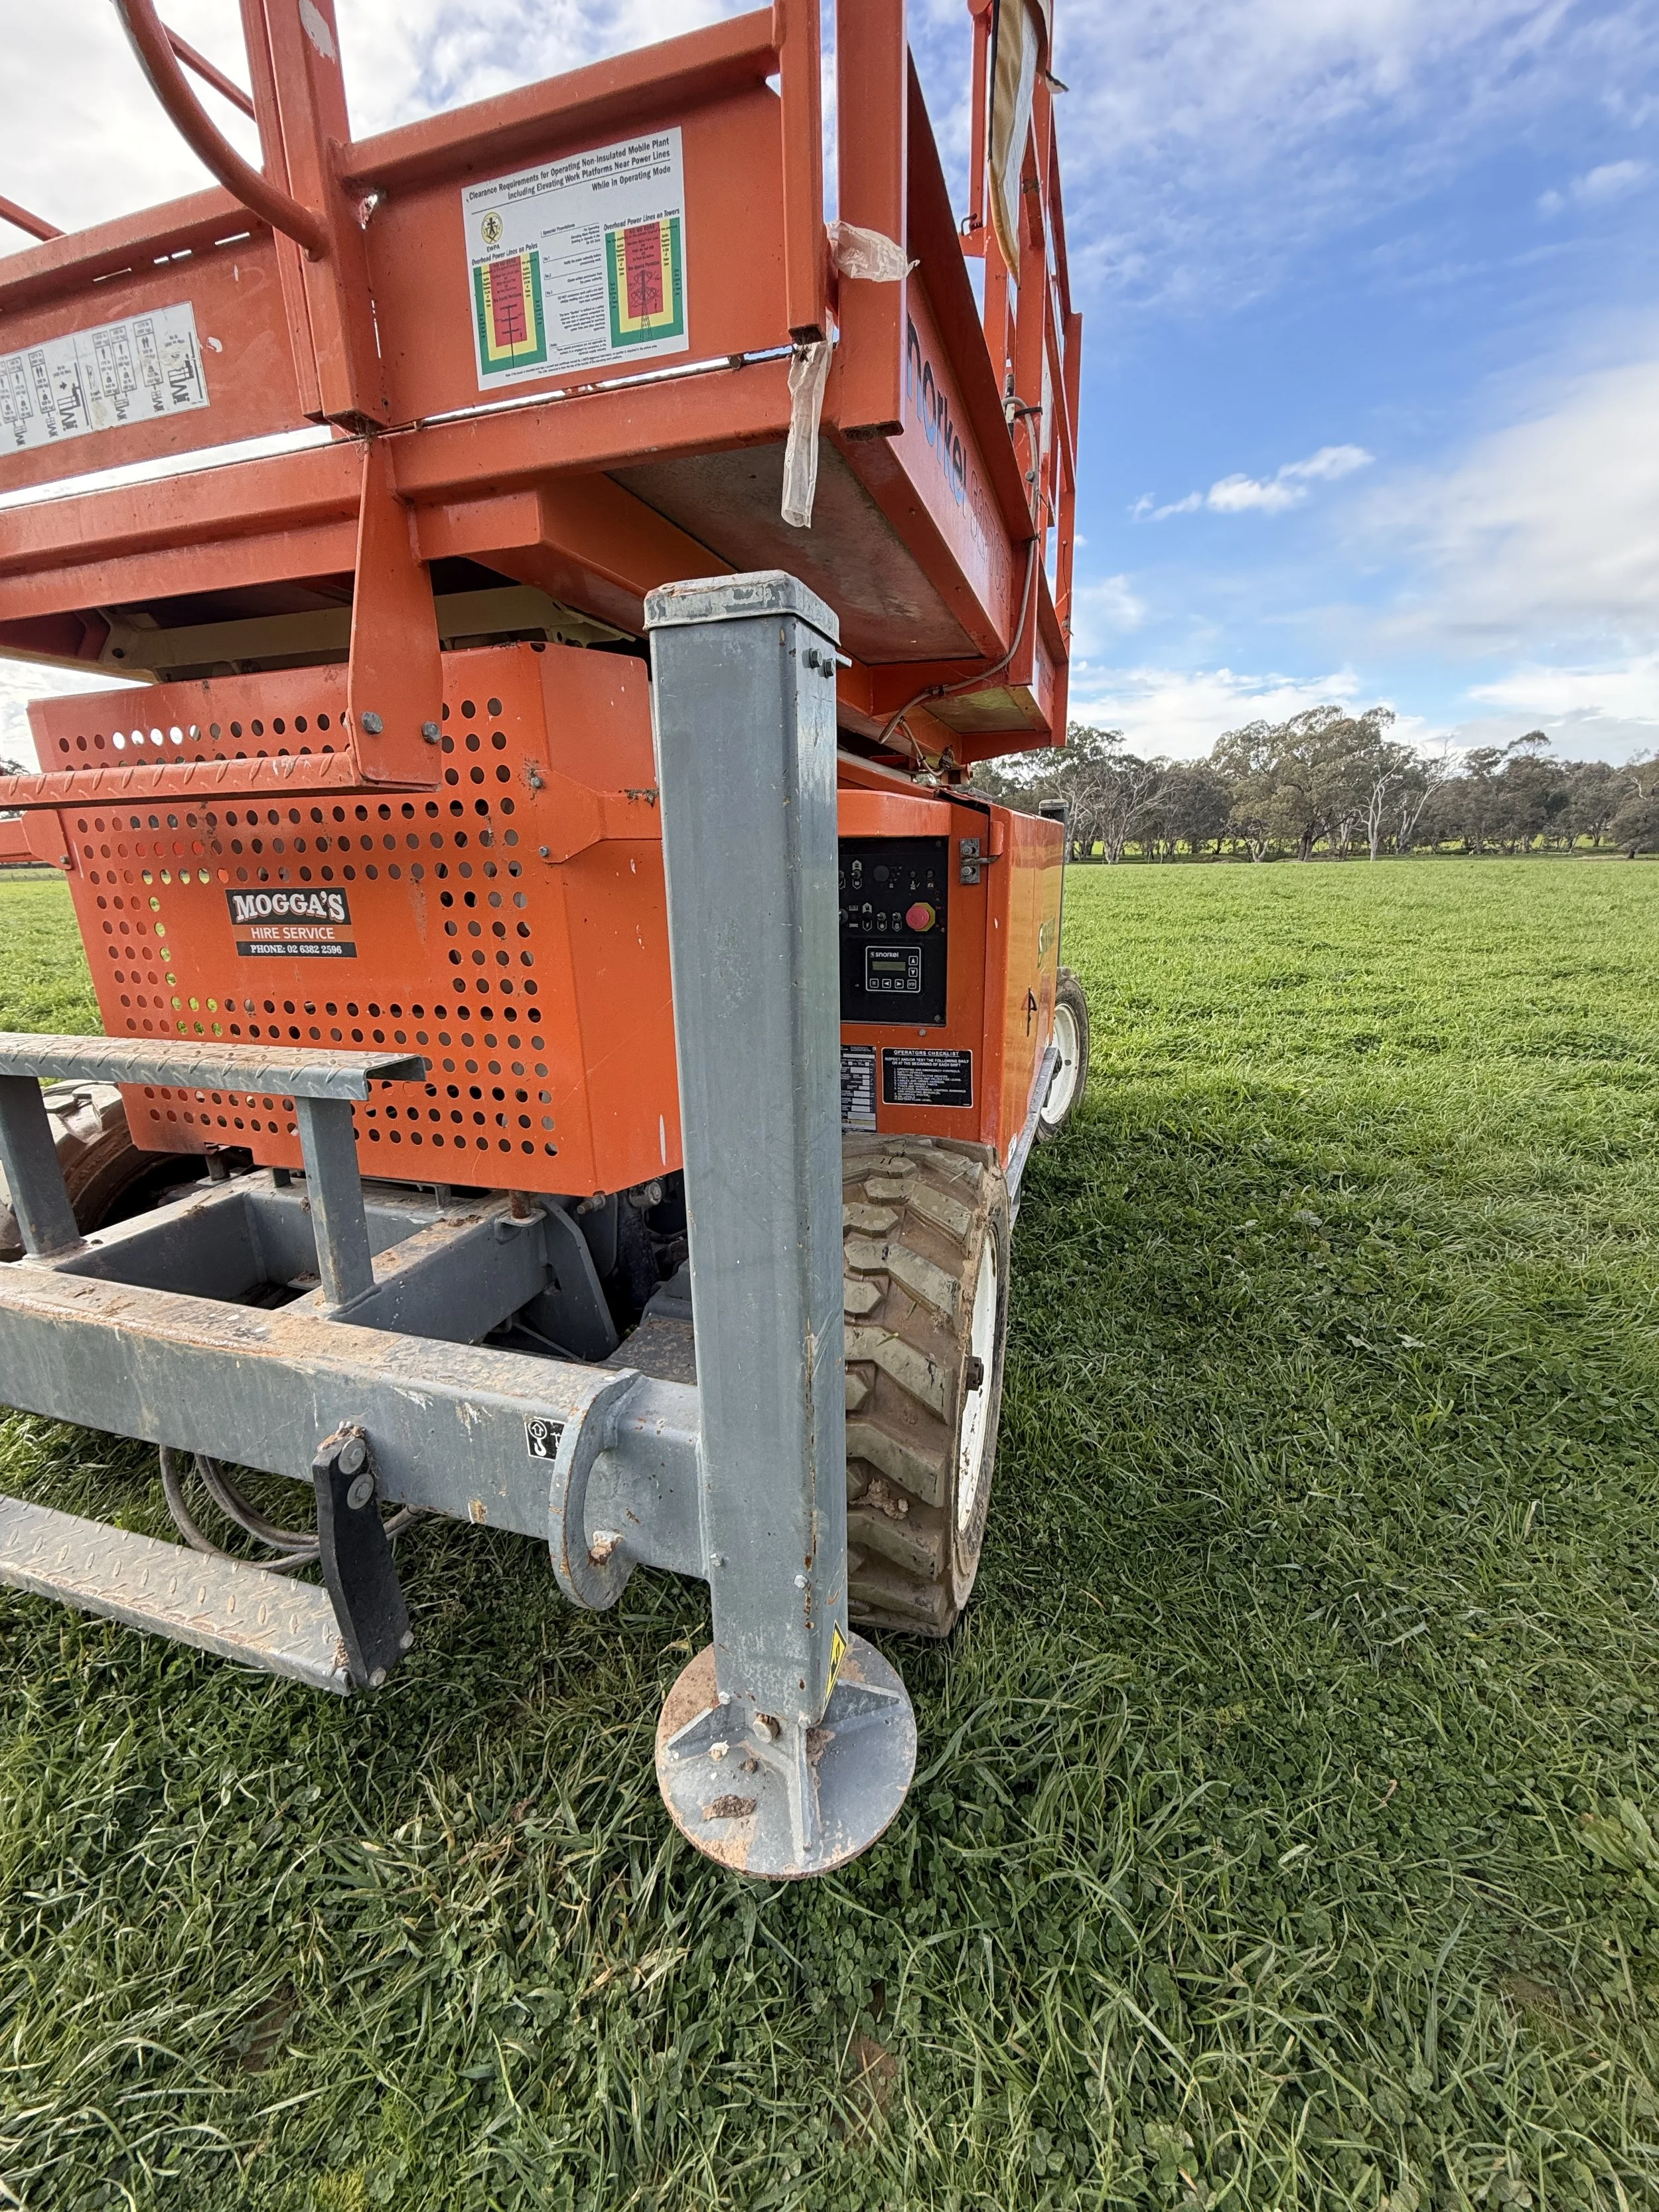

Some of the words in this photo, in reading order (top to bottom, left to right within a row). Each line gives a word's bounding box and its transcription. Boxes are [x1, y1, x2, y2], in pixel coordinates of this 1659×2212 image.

[469, 186, 497, 200] Clearance
[499, 174, 539, 192] Requirements
[551, 161, 580, 178] Operating
[582, 148, 626, 167] Non-Insulated
[628, 143, 650, 156] Mobile
[652, 137, 669, 149] Plant
[508, 186, 535, 200] Including
[537, 178, 564, 192] Elevating
[565, 171, 580, 184] Work
[582, 164, 612, 178] Platforms
[614, 160, 629, 170] Near
[632, 155, 651, 166] Power
[653, 150, 670, 160] Lines
[592, 180, 610, 191] While
[619, 170, 651, 184] Operating
[653, 165, 671, 176] Mode
[604, 219, 626, 231] Overhead
[627, 217, 642, 225] Power
[664, 208, 680, 217] Towers
[472, 255, 491, 265] Overhead
[907, 312, 967, 519] norkel
[233, 891, 345, 923] MOGGA'S
[251, 927, 280, 939] HIRE
[283, 927, 335, 939] SERVICE
[250, 945, 286, 953] PHONE:
[287, 945, 298, 953] 02
[300, 945, 320, 954] 6382
[321, 945, 342, 954] 2596
